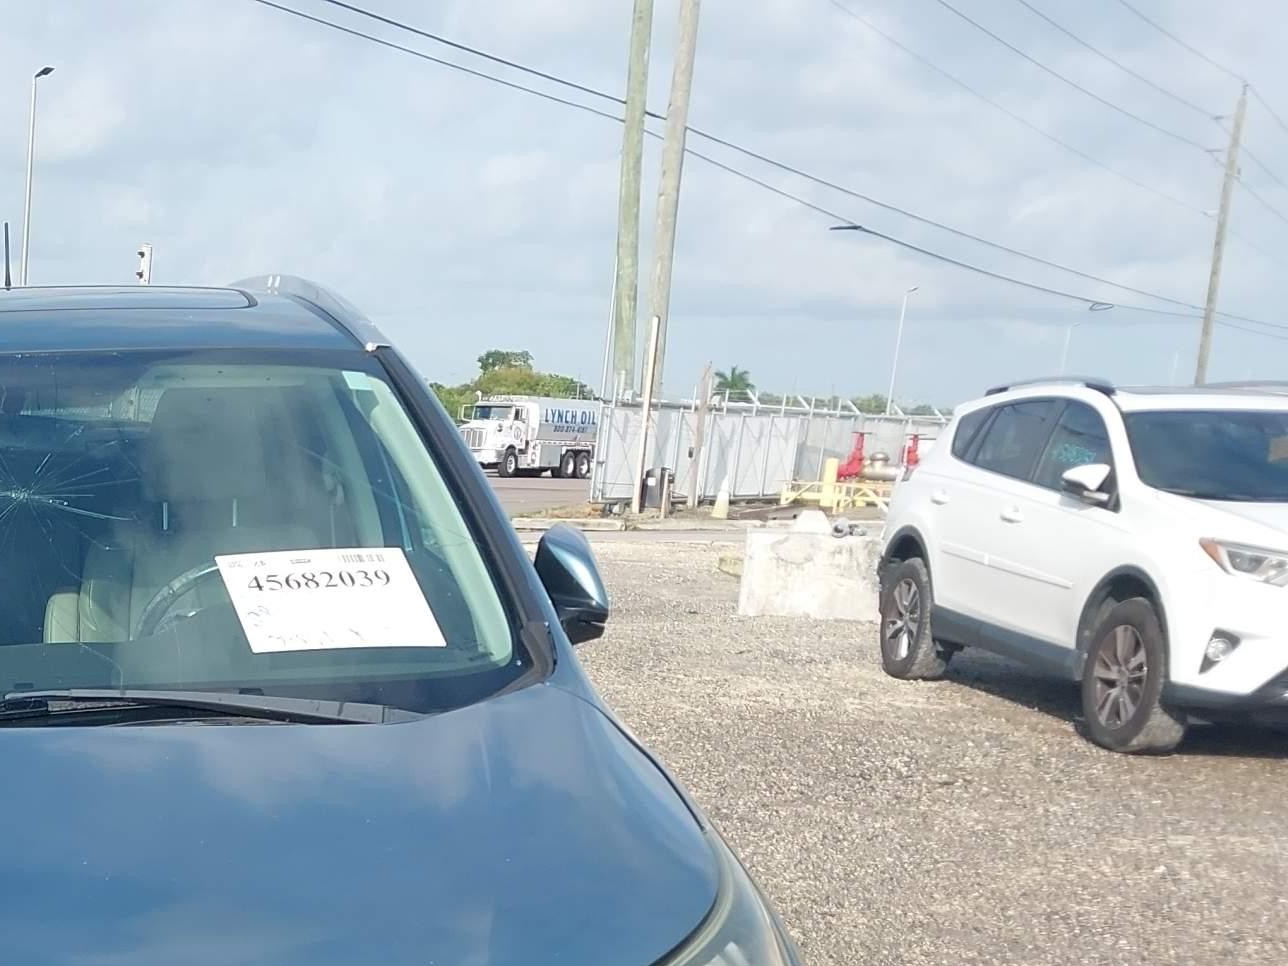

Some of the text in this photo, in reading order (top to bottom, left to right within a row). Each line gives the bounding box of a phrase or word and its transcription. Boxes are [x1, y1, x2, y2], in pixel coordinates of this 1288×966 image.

[545, 408, 597, 426] LYNCH OIL
[247, 569, 392, 592] 45682039
